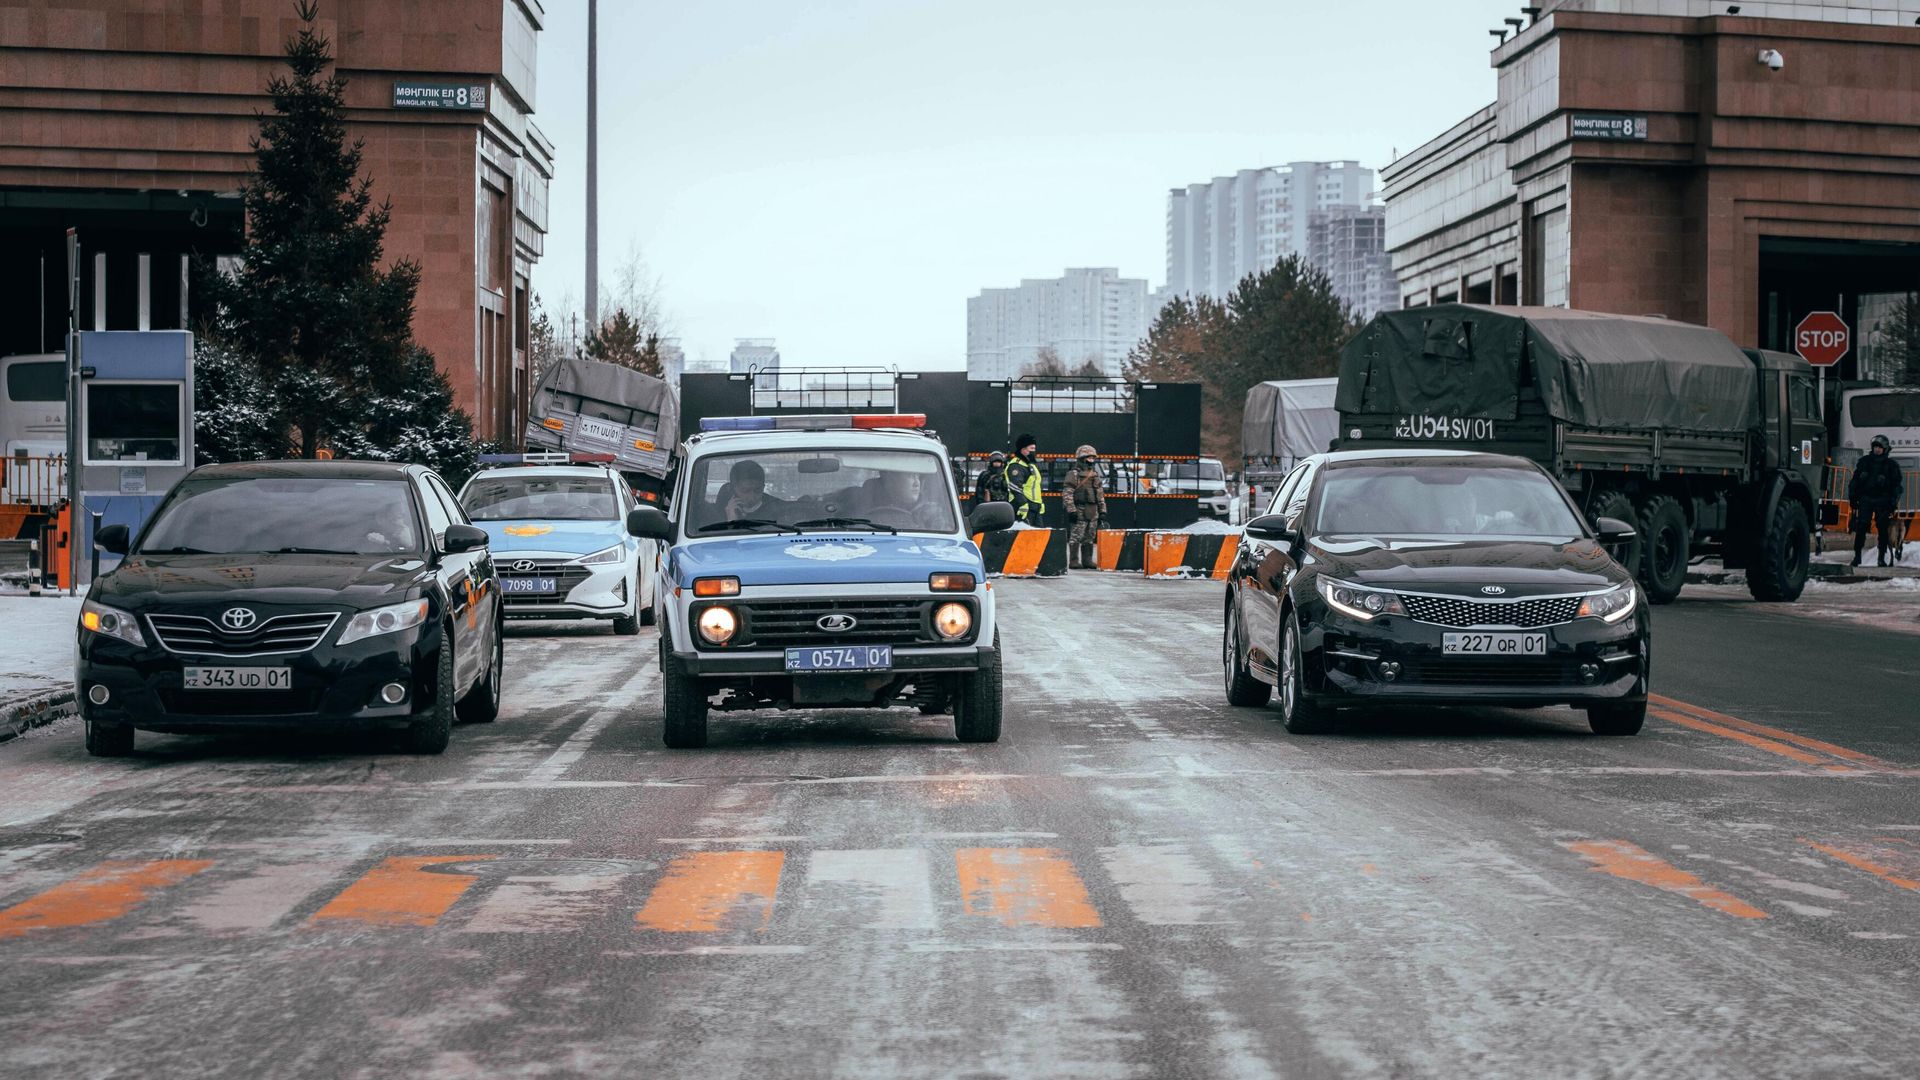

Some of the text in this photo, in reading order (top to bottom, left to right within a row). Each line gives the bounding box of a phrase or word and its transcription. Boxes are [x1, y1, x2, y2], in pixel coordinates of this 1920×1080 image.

[441, 89, 455, 98] ЕЛ
[456, 87, 468, 105] 8
[1611, 120, 1622, 129] ЕЛ
[1623, 118, 1633, 136] 8
[1799, 330, 1846, 348] STOP
[590, 424, 600, 435] 171
[611, 429, 618, 439] 01
[1395, 414, 1494, 440] KZ 054 SV 01
[507, 579, 555, 591] 7098 01
[1444, 635, 1544, 653] KZ 227 QR 01
[787, 648, 890, 668] KZ 0574 01
[185, 669, 289, 687] KZ 343 UD 01
